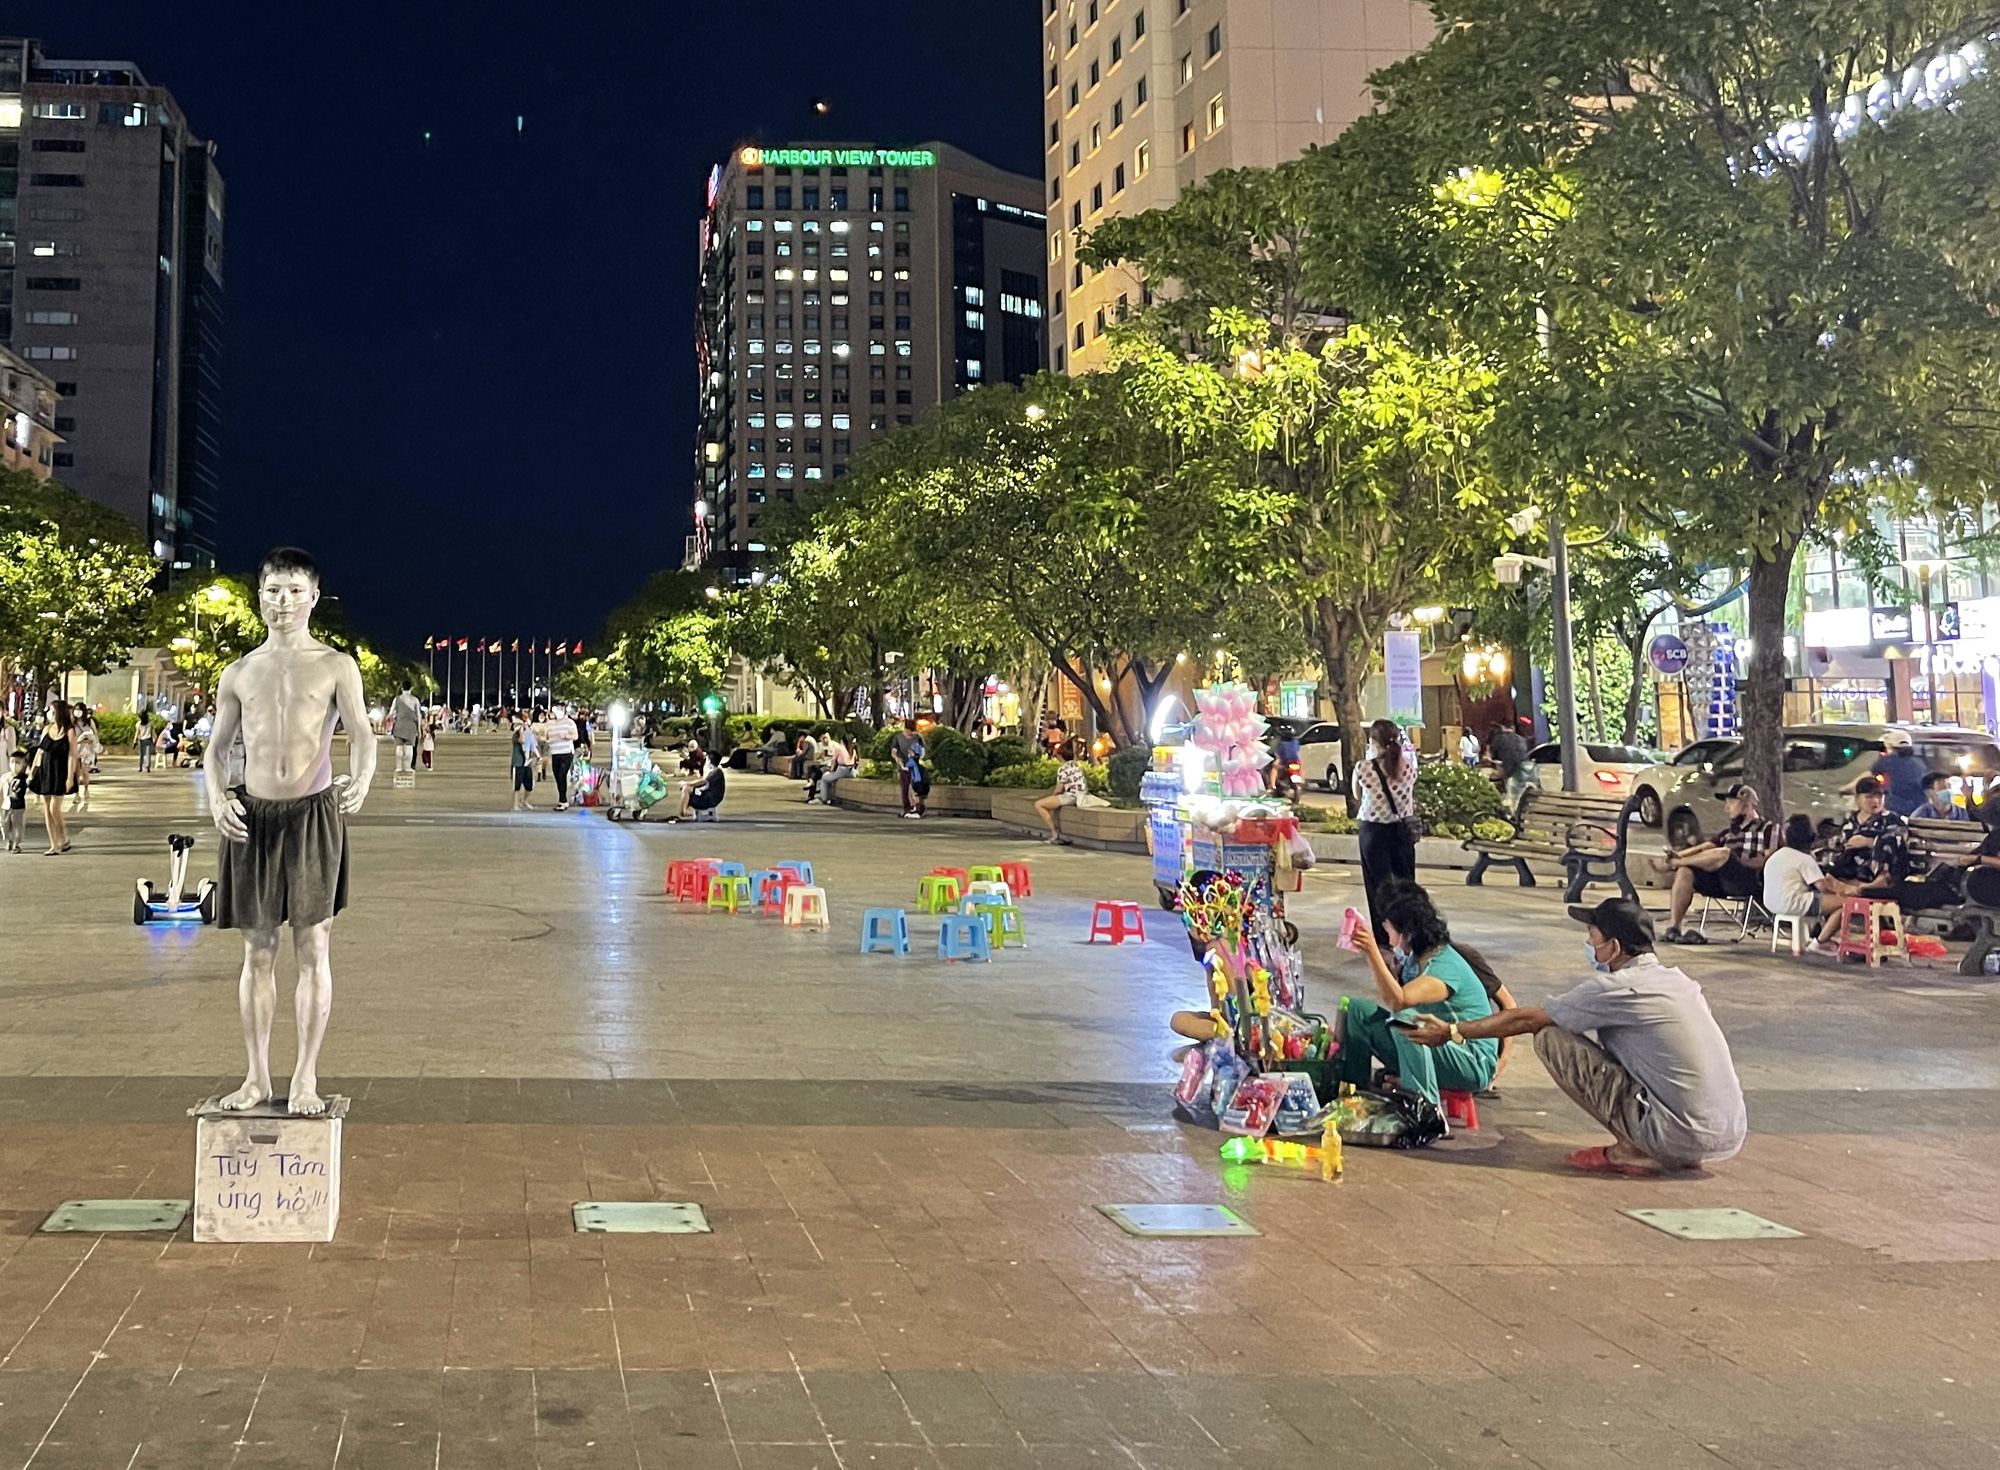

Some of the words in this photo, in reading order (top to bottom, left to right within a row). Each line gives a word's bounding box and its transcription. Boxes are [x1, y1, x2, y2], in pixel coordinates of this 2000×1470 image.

[758, 149, 832, 165] HARBOUR
[834, 150, 874, 165] VIEW
[876, 150, 935, 166] TOWER
[1666, 649, 1687, 659] SCB
[268, 1153, 328, 1178] Tâm
